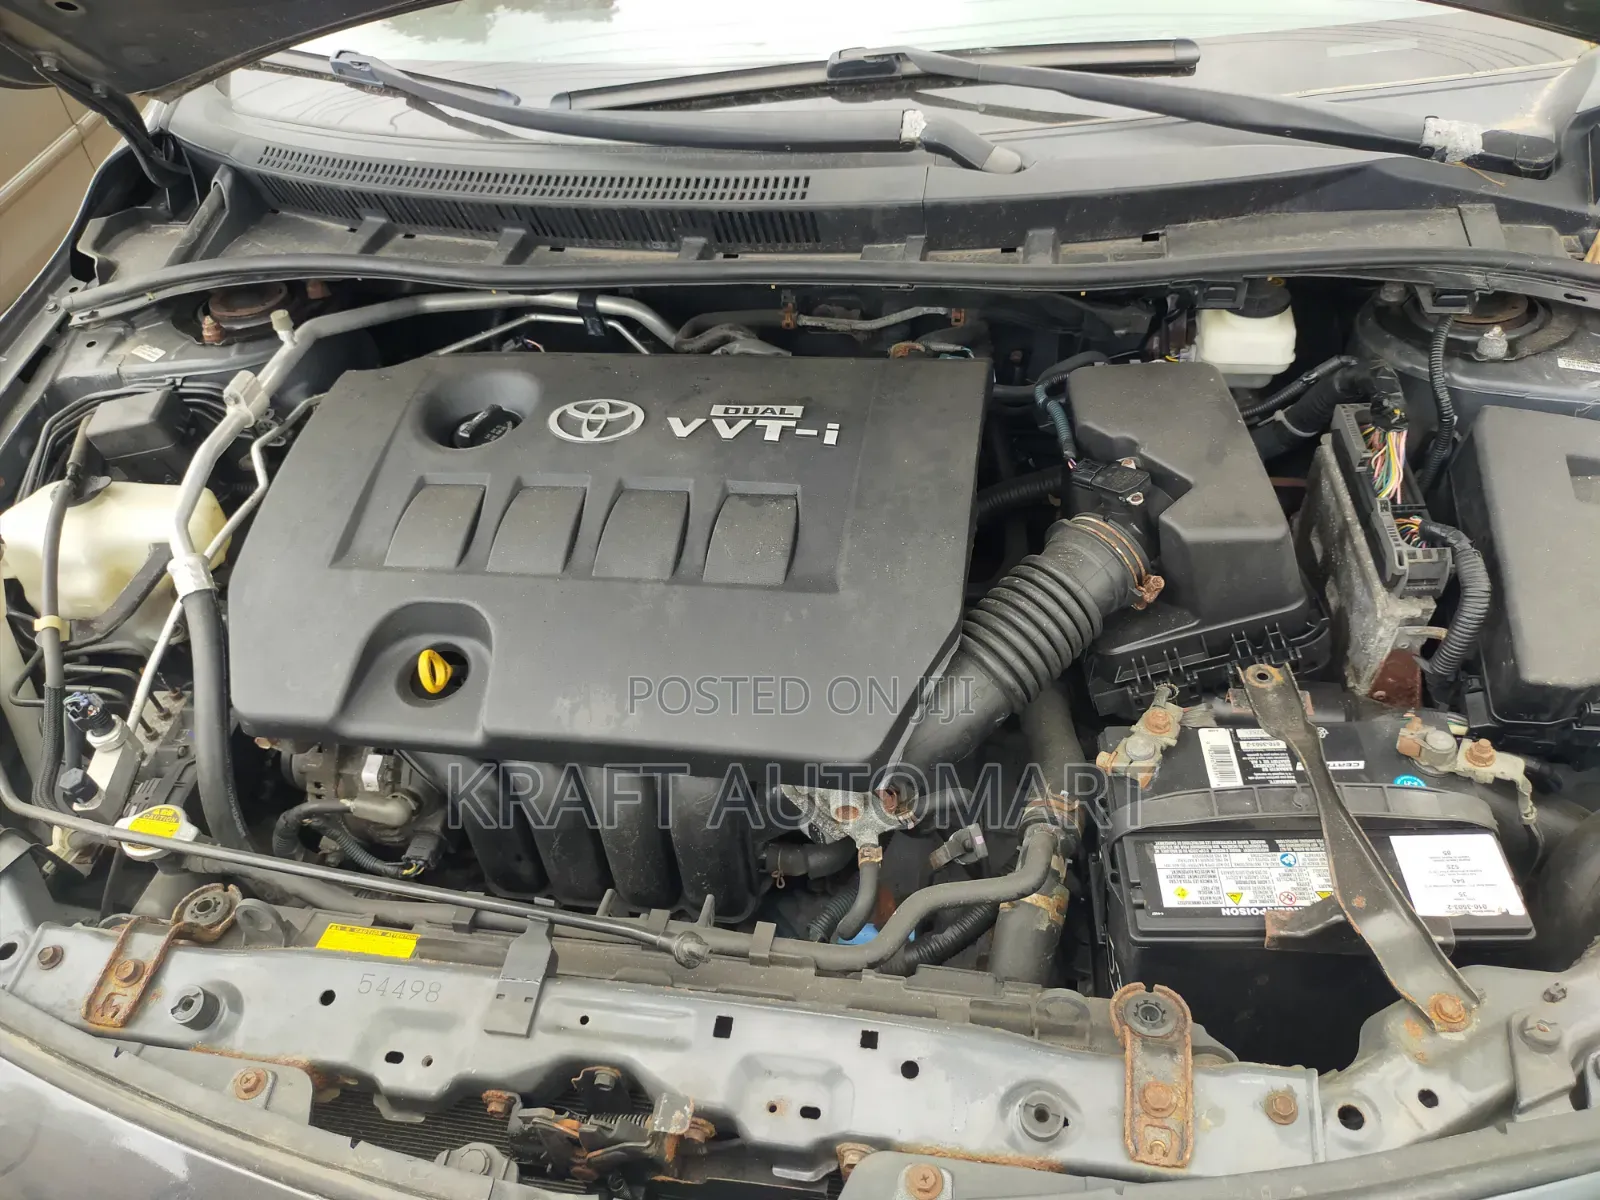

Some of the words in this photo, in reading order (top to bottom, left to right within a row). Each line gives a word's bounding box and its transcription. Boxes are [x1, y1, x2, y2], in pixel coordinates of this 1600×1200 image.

[722, 404, 795, 417] DUAL
[667, 416, 840, 446] VVT-i
[143, 814, 178, 823] CAUTION
[353, 928, 383, 937] CAUTION
[357, 972, 442, 1003] 54498
